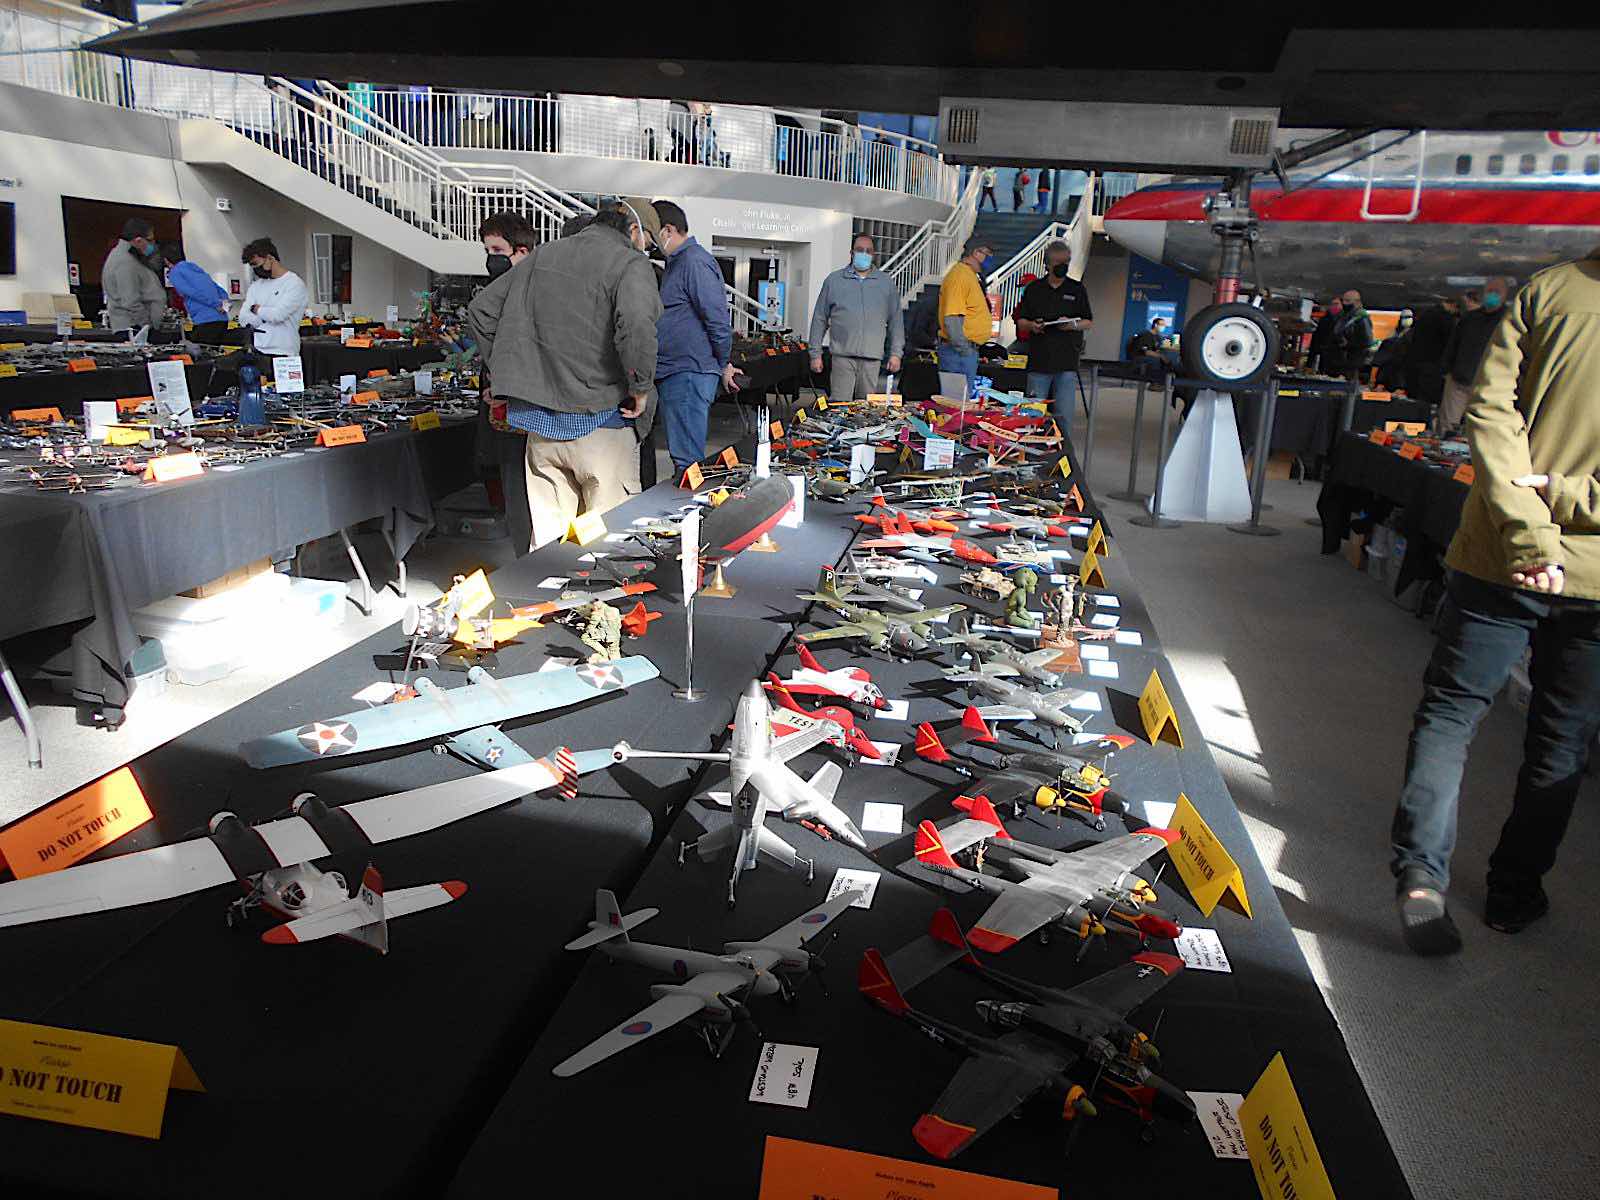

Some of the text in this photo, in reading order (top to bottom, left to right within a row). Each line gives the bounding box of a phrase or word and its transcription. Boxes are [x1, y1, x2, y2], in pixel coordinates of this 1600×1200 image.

[826, 571, 833, 583] P
[788, 715, 815, 729] TEST
[37, 844, 57, 862] DO
[57, 829, 83, 852] NOT
[1194, 850, 1214, 881] TOUCH
[9, 1067, 50, 1091] NOT
[56, 1075, 122, 1104] TOUCH
[1260, 1114, 1273, 1140] DO
[1266, 1137, 1285, 1173] NOT
